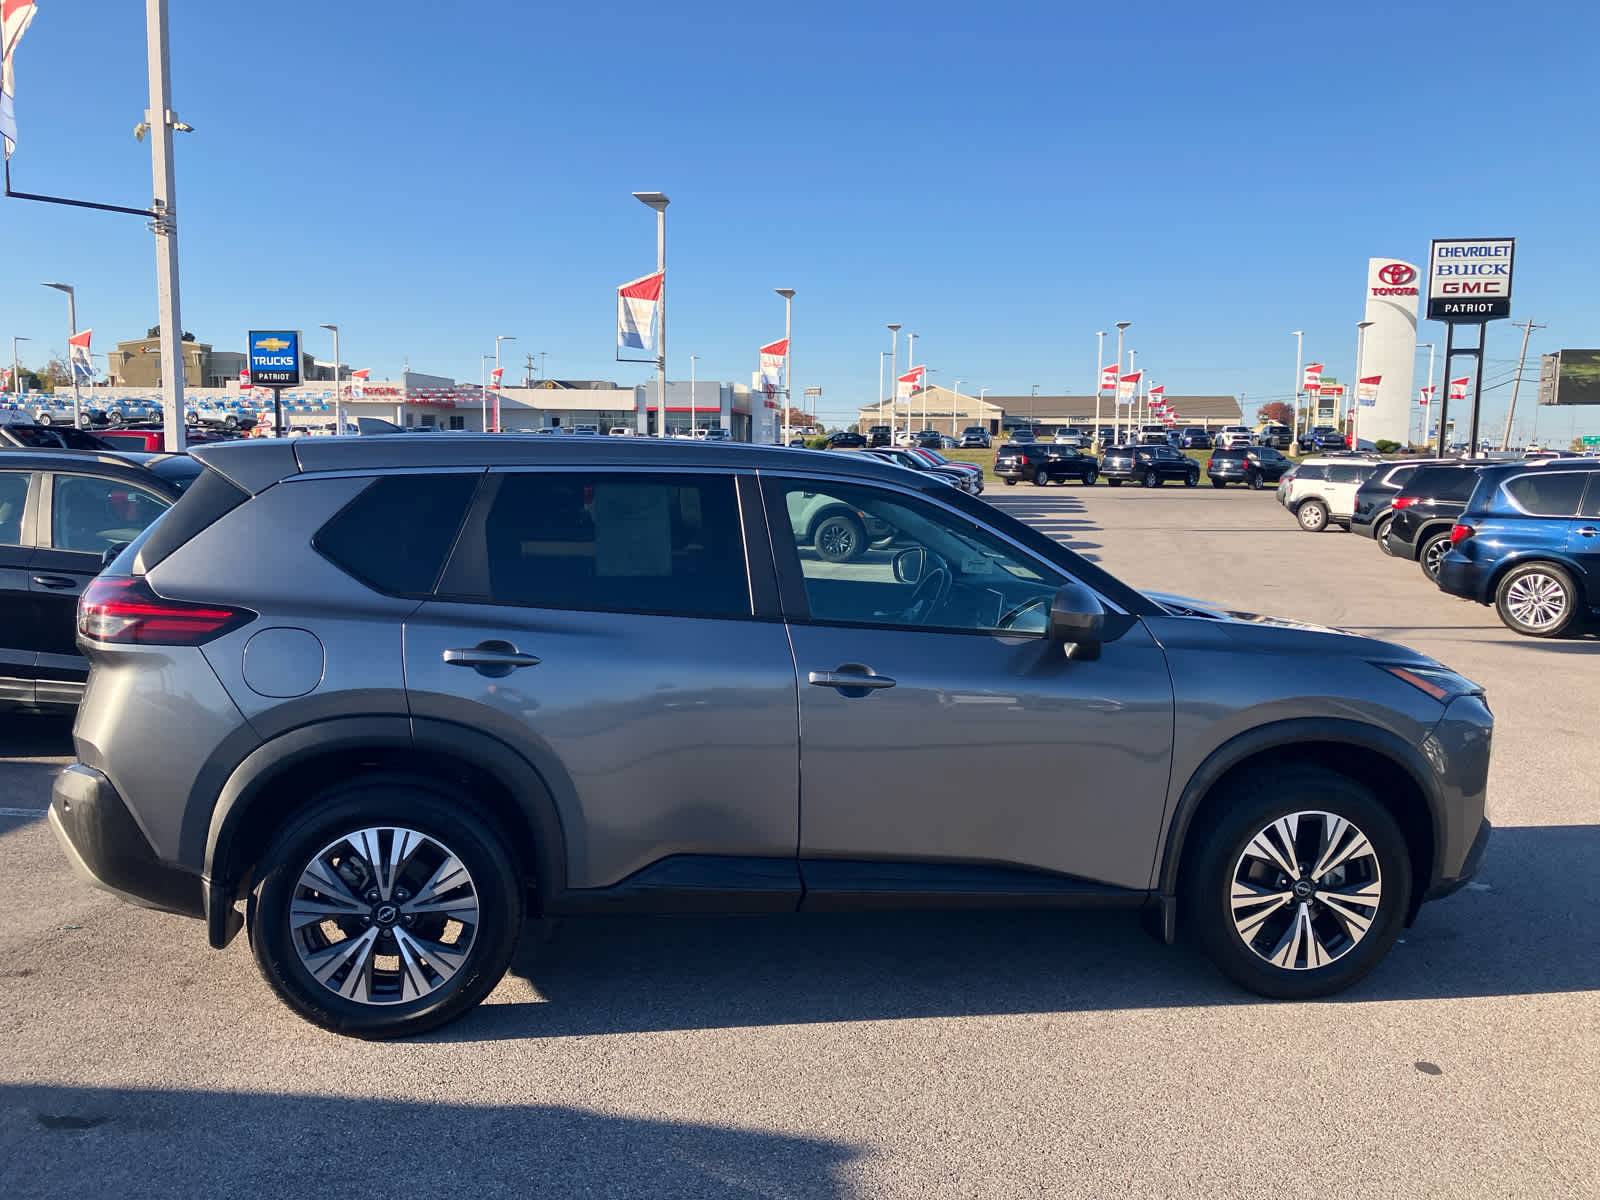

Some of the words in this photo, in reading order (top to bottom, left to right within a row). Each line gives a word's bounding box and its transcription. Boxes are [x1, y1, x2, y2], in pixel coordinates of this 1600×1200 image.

[1438, 246, 1510, 258] CHEVROLET
[1436, 263, 1509, 276] BUICK
[1371, 287, 1419, 296] TOYOTA
[1442, 282, 1501, 294] GMC
[1444, 303, 1494, 313] PATRIOT
[253, 356, 294, 366] TRUCKS
[258, 373, 289, 381] PATRIOT
